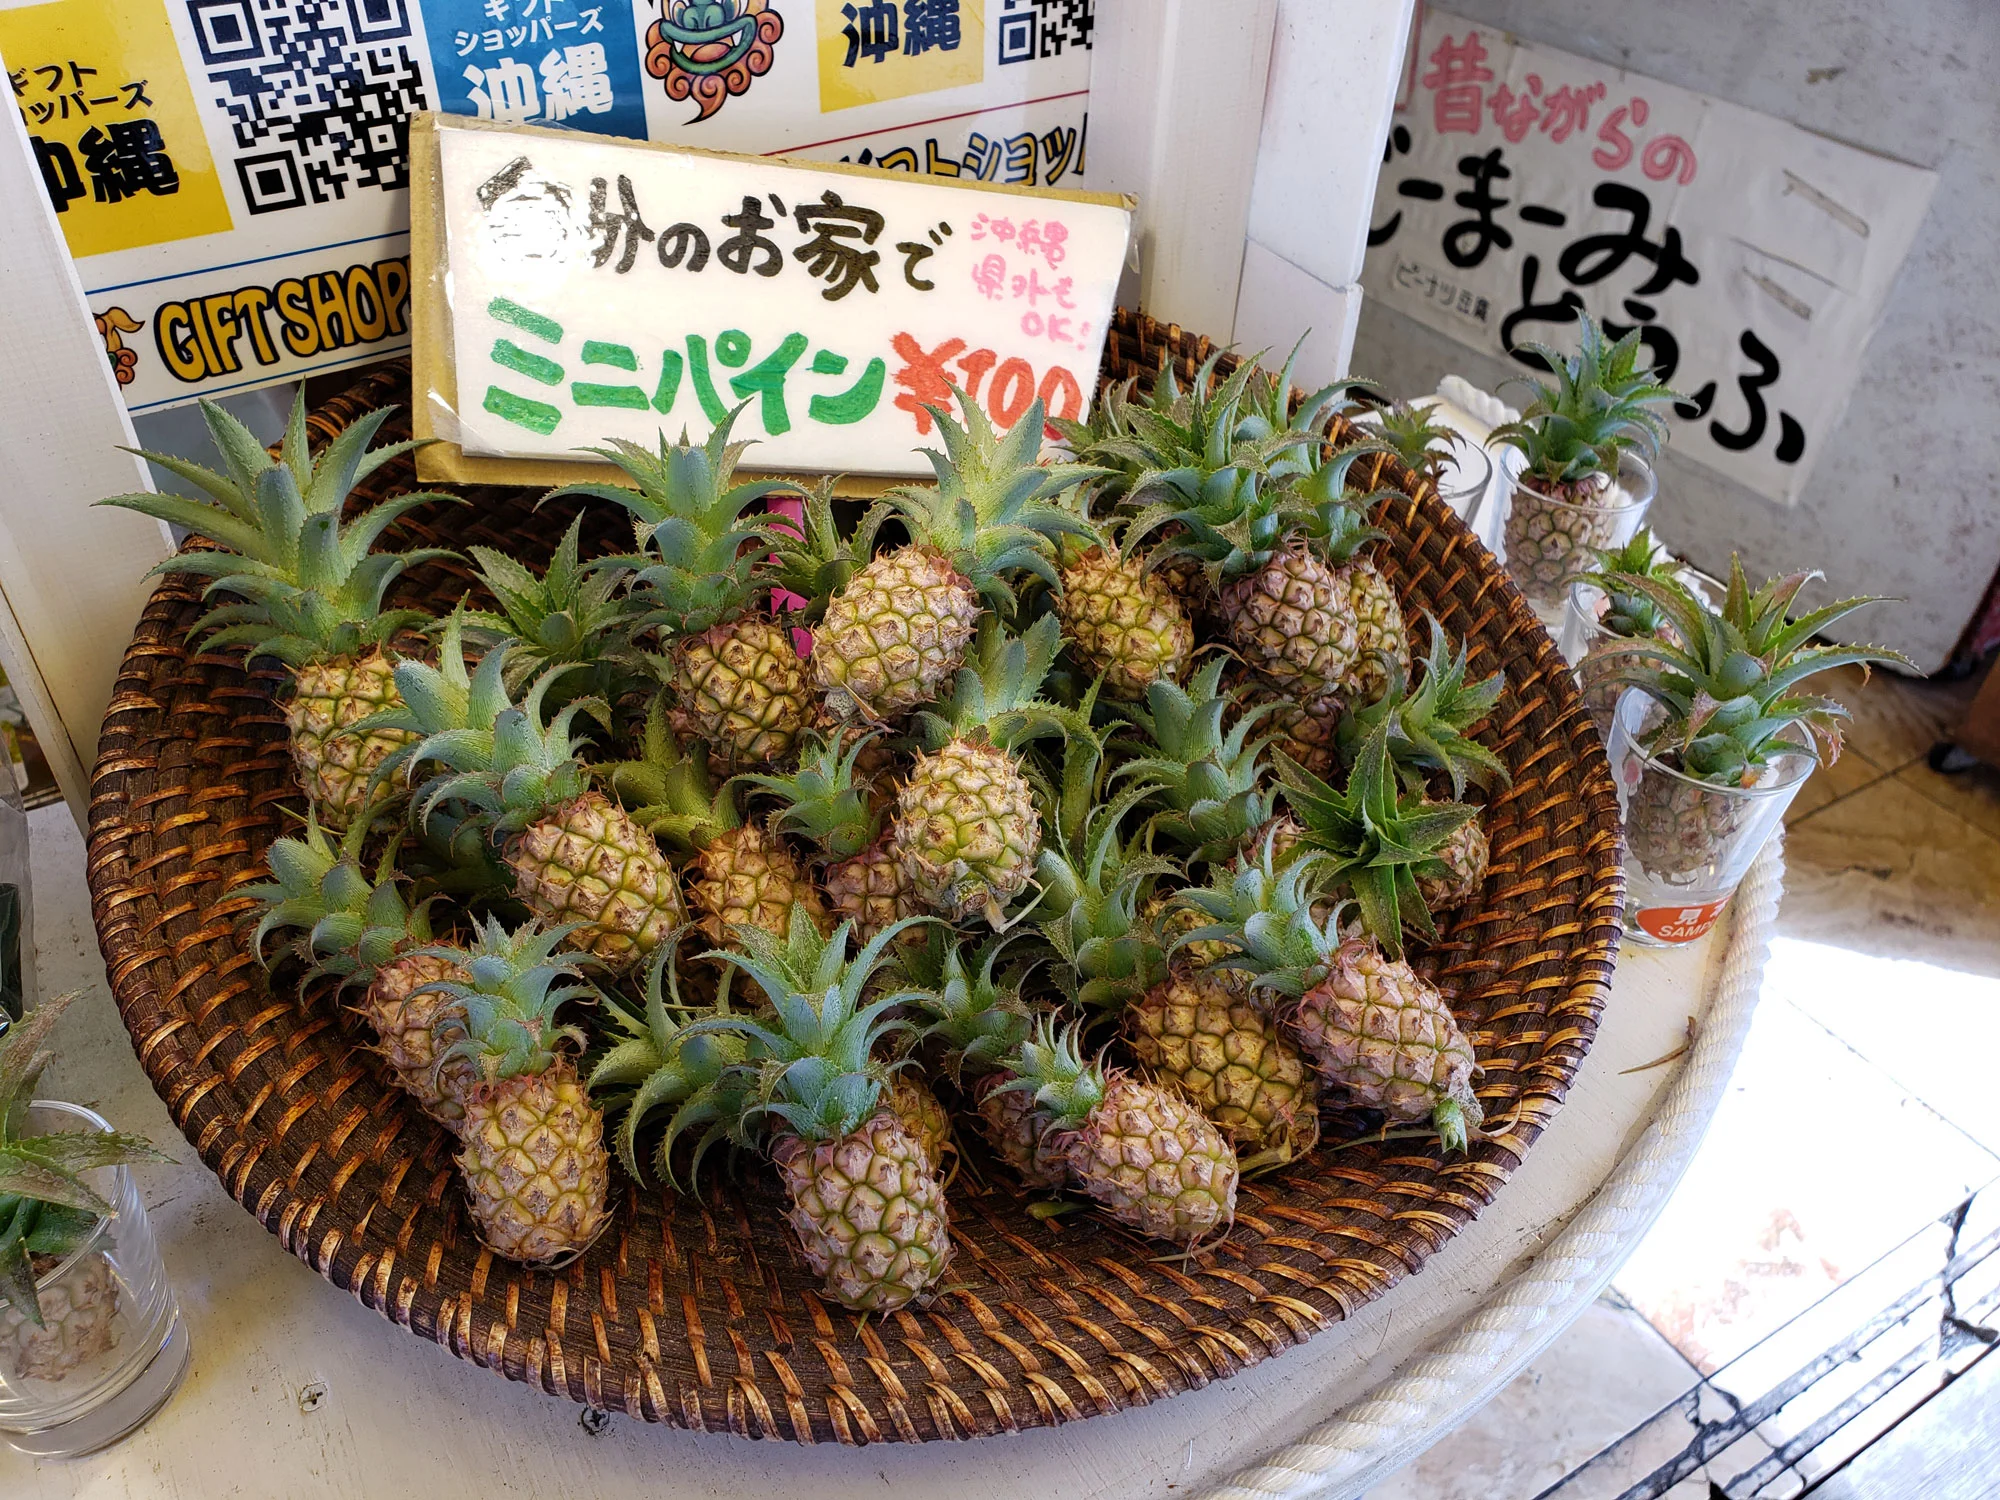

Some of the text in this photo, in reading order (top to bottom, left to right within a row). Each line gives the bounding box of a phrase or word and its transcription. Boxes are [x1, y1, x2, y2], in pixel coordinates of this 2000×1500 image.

[454, 6, 604, 57] ショッパーズ
[840, 0, 961, 68] 沖縄
[19, 80, 153, 126] ッパーズ
[463, 42, 613, 122] 沖縄
[1422, 30, 1697, 187] 昔ながらの
[970, 212, 1069, 271] 沖縄
[971, 253, 1077, 309] 県外も
[154, 254, 411, 382] GIFT SHOP
[1020, 311, 1091, 351] OK!
[482, 298, 1082, 441] ミニパイン ¥100
